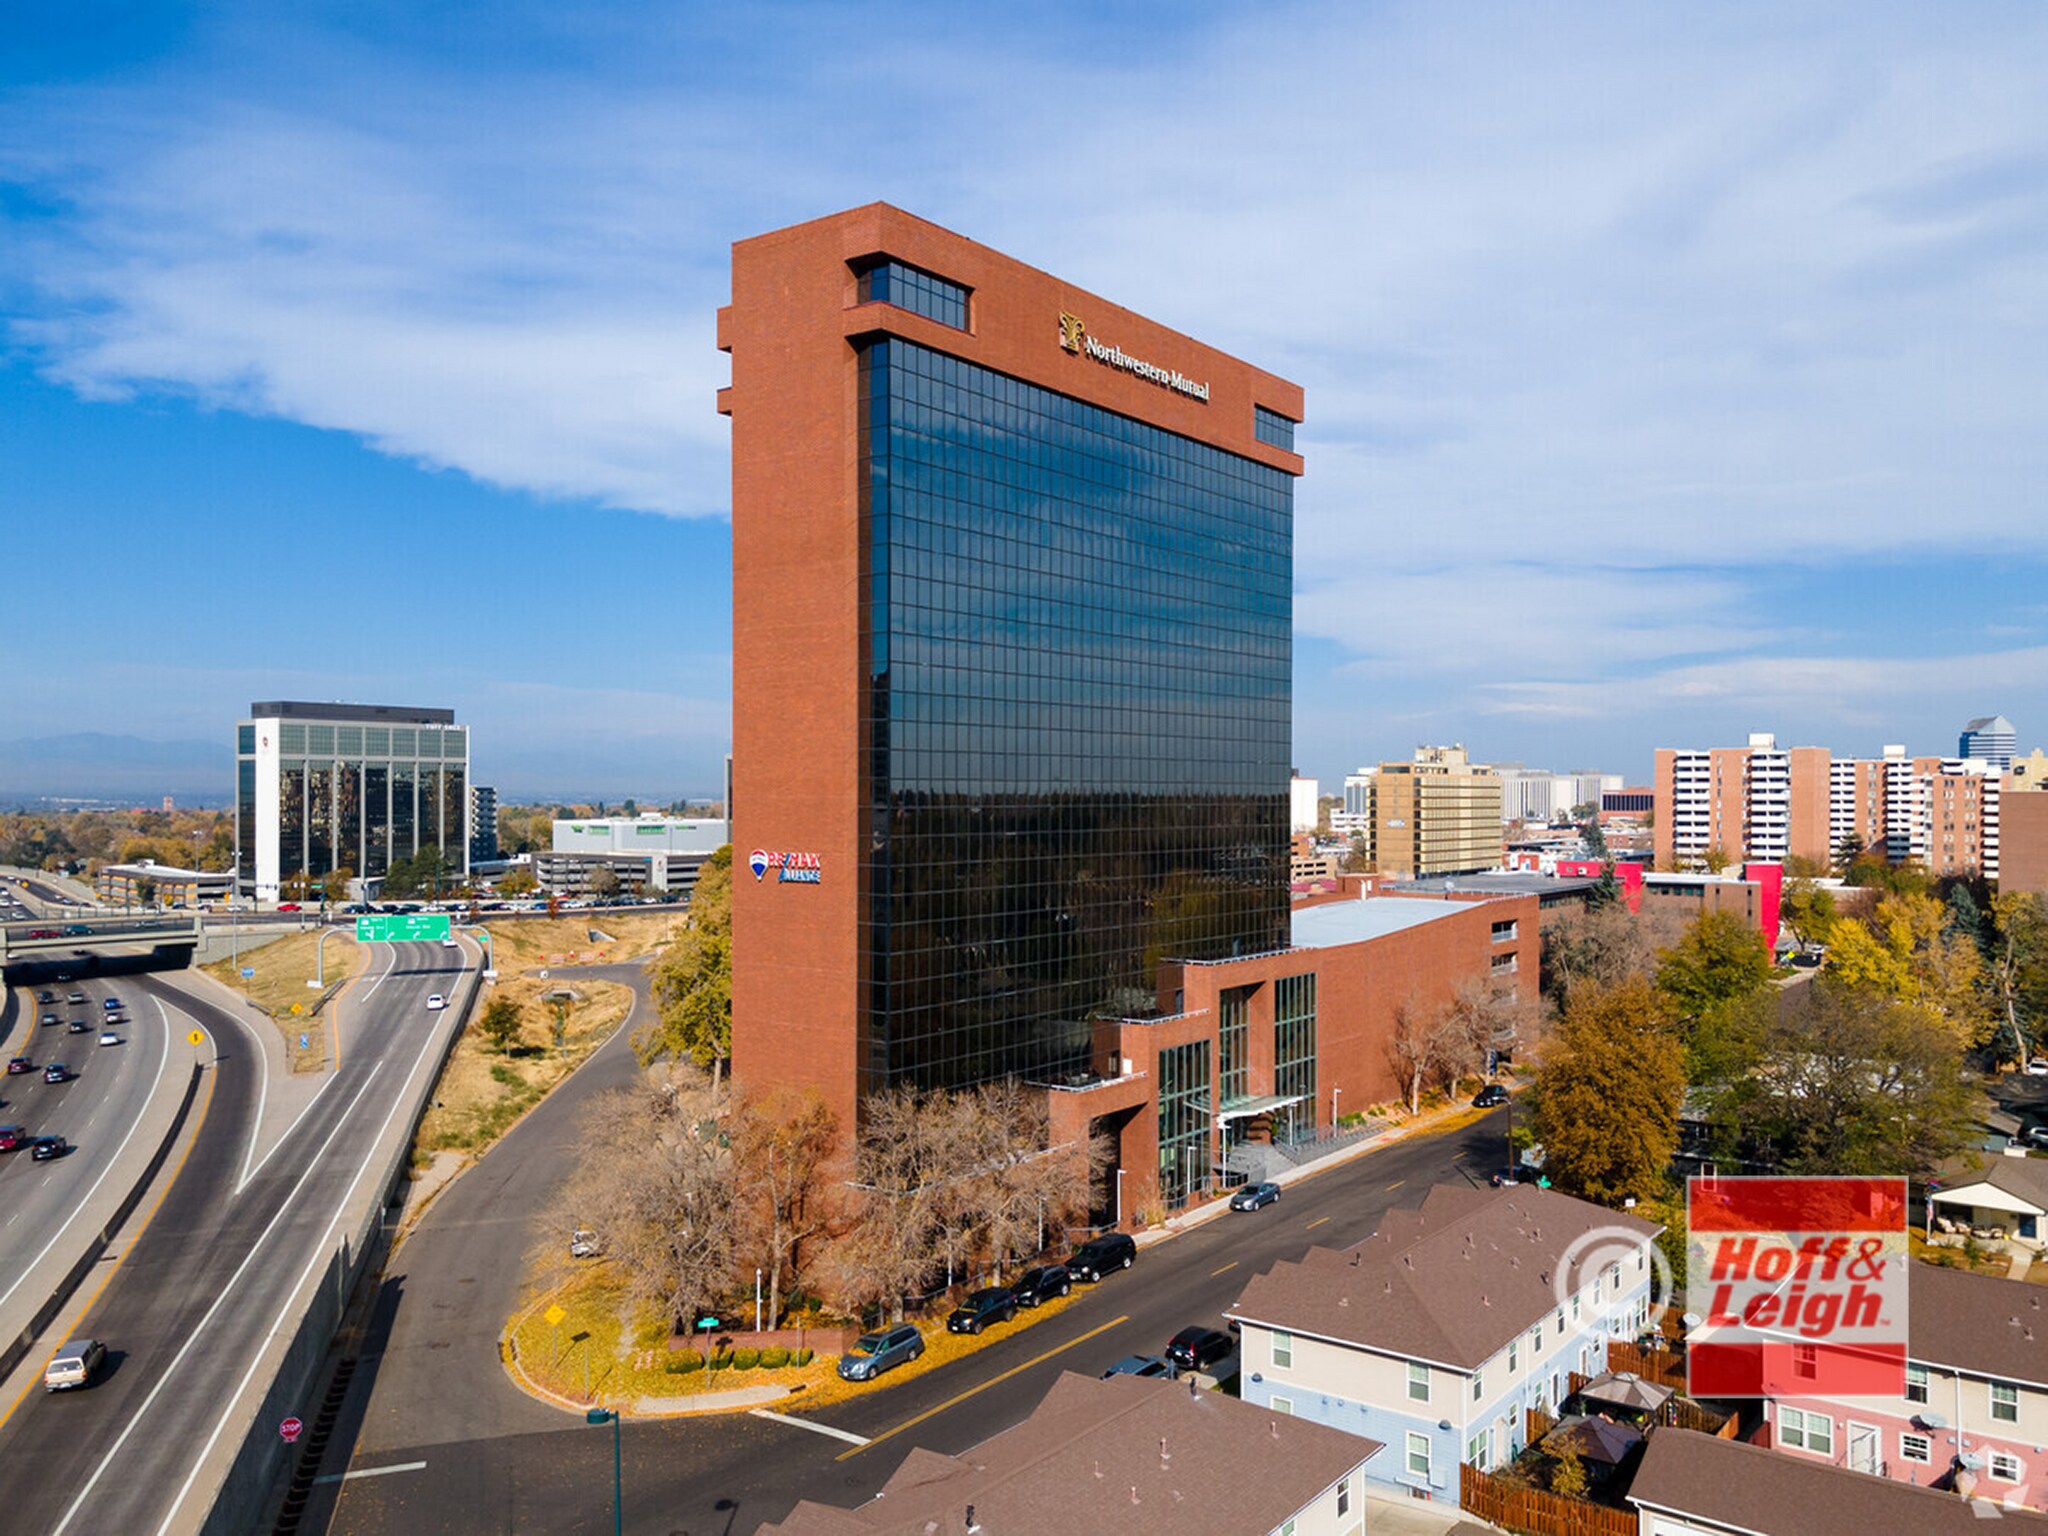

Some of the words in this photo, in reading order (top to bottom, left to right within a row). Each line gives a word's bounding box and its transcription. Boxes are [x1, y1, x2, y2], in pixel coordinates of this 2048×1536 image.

[1085, 335, 1168, 385] Northwestern
[1170, 369, 1209, 401] Mutual
[768, 852, 820, 868] RE/MAX
[281, 1423, 301, 1433] STOP
